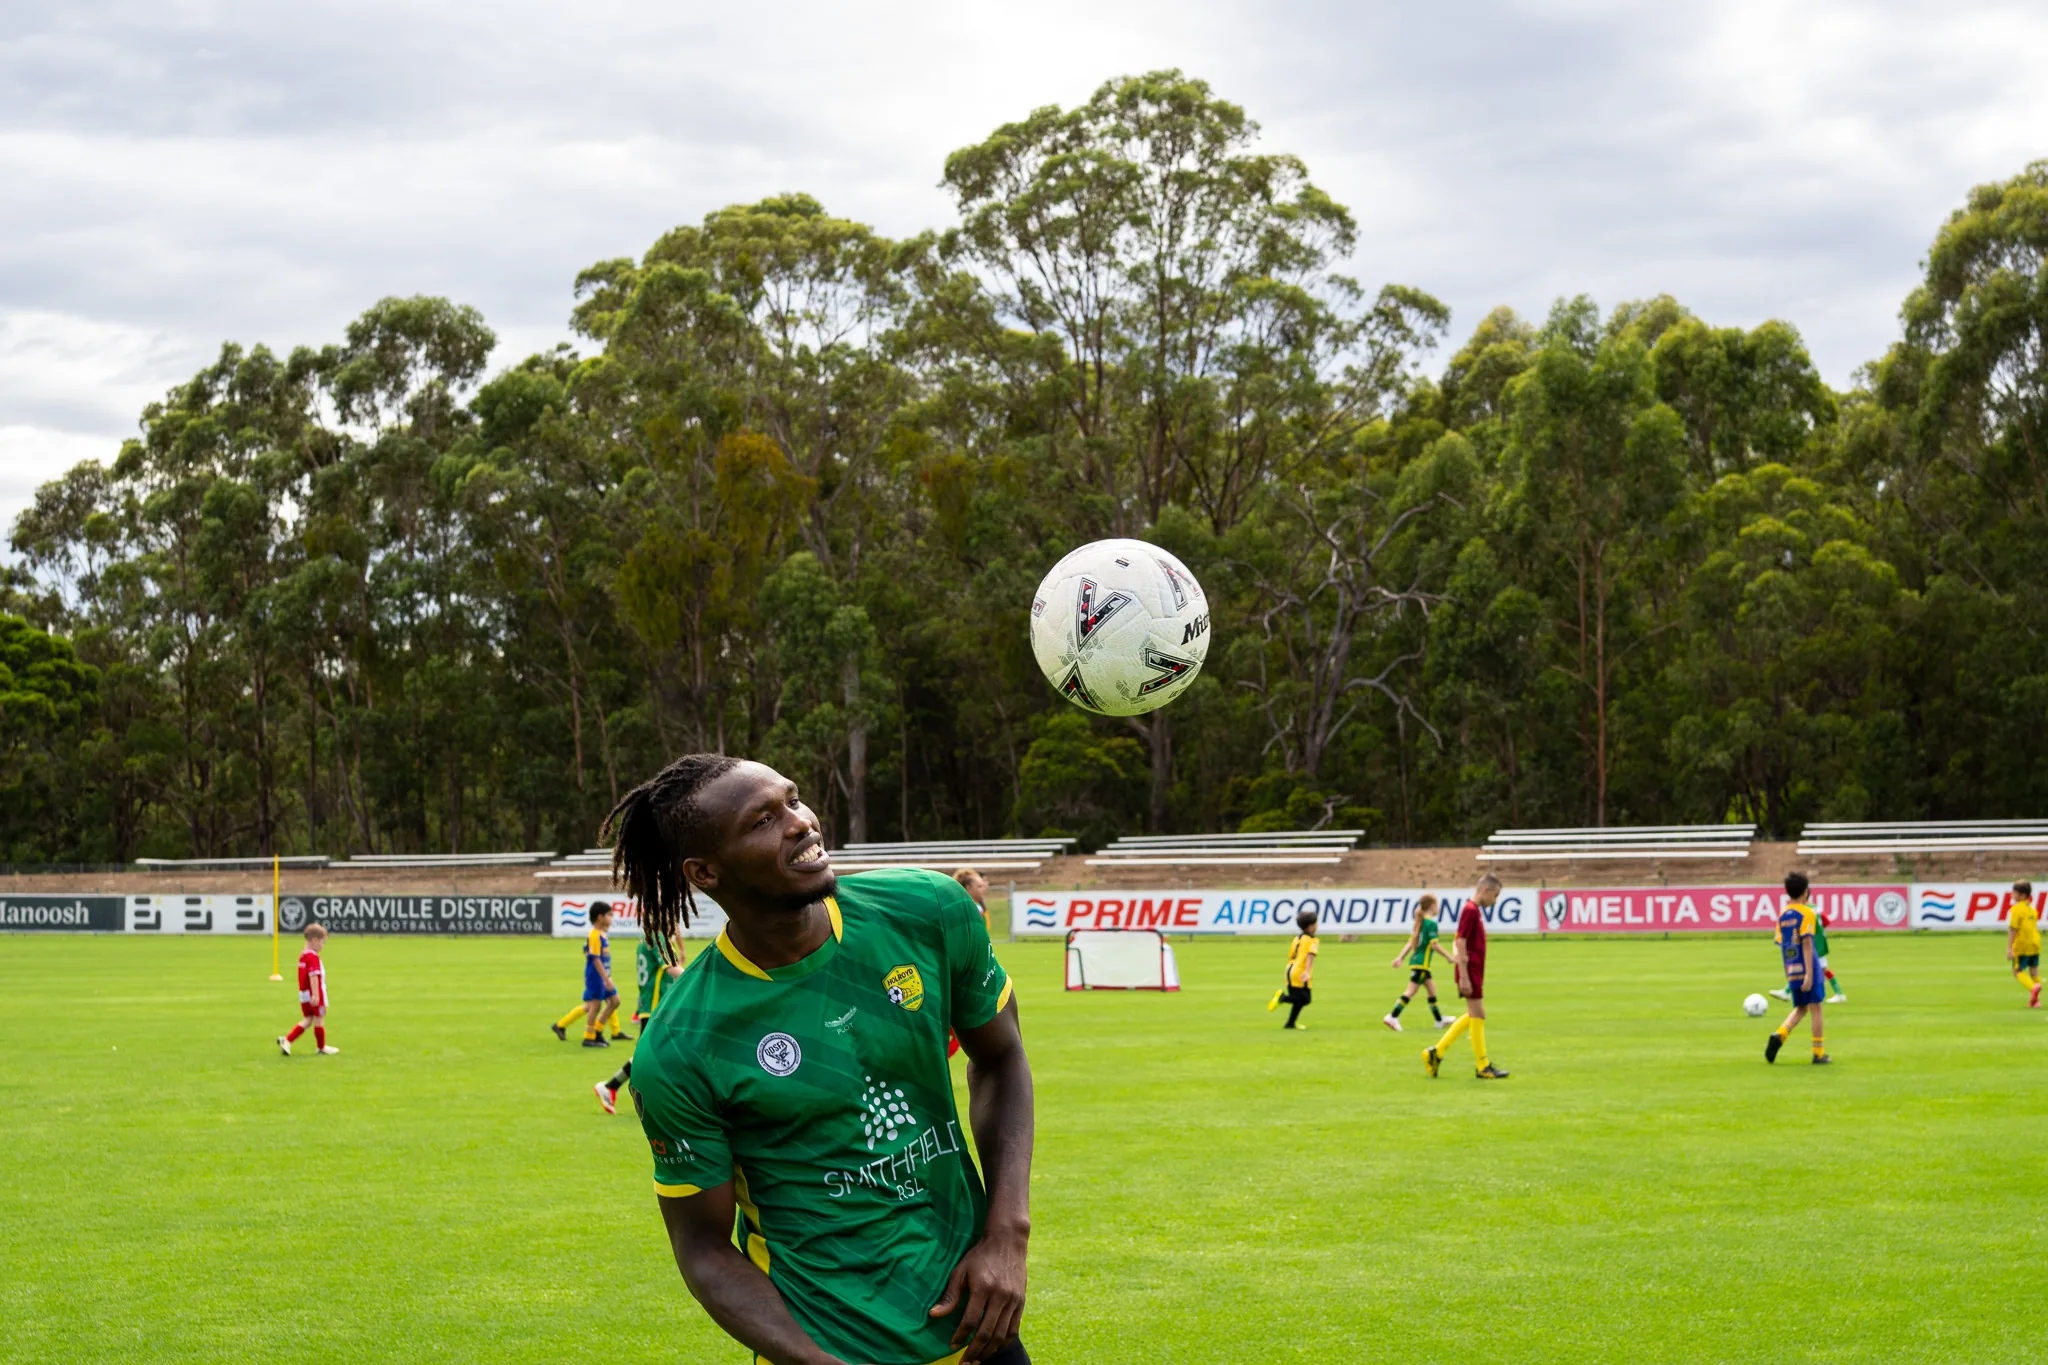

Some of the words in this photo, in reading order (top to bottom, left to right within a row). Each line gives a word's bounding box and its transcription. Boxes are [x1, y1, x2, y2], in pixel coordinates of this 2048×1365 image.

[312, 898, 434, 919] GRANVILLE
[440, 898, 541, 919] DISTRICT
[1064, 899, 1203, 928] PRIME
[1213, 897, 1523, 925] AIRCONDITING
[1571, 895, 1701, 925] MELITA
[1709, 893, 1870, 923] STAUM
[373, 920, 442, 932] FOOTBALL
[448, 920, 544, 932] ASSOCIATION
[886, 968, 914, 986] HOLROYD
[896, 1177, 924, 1201] RSL
